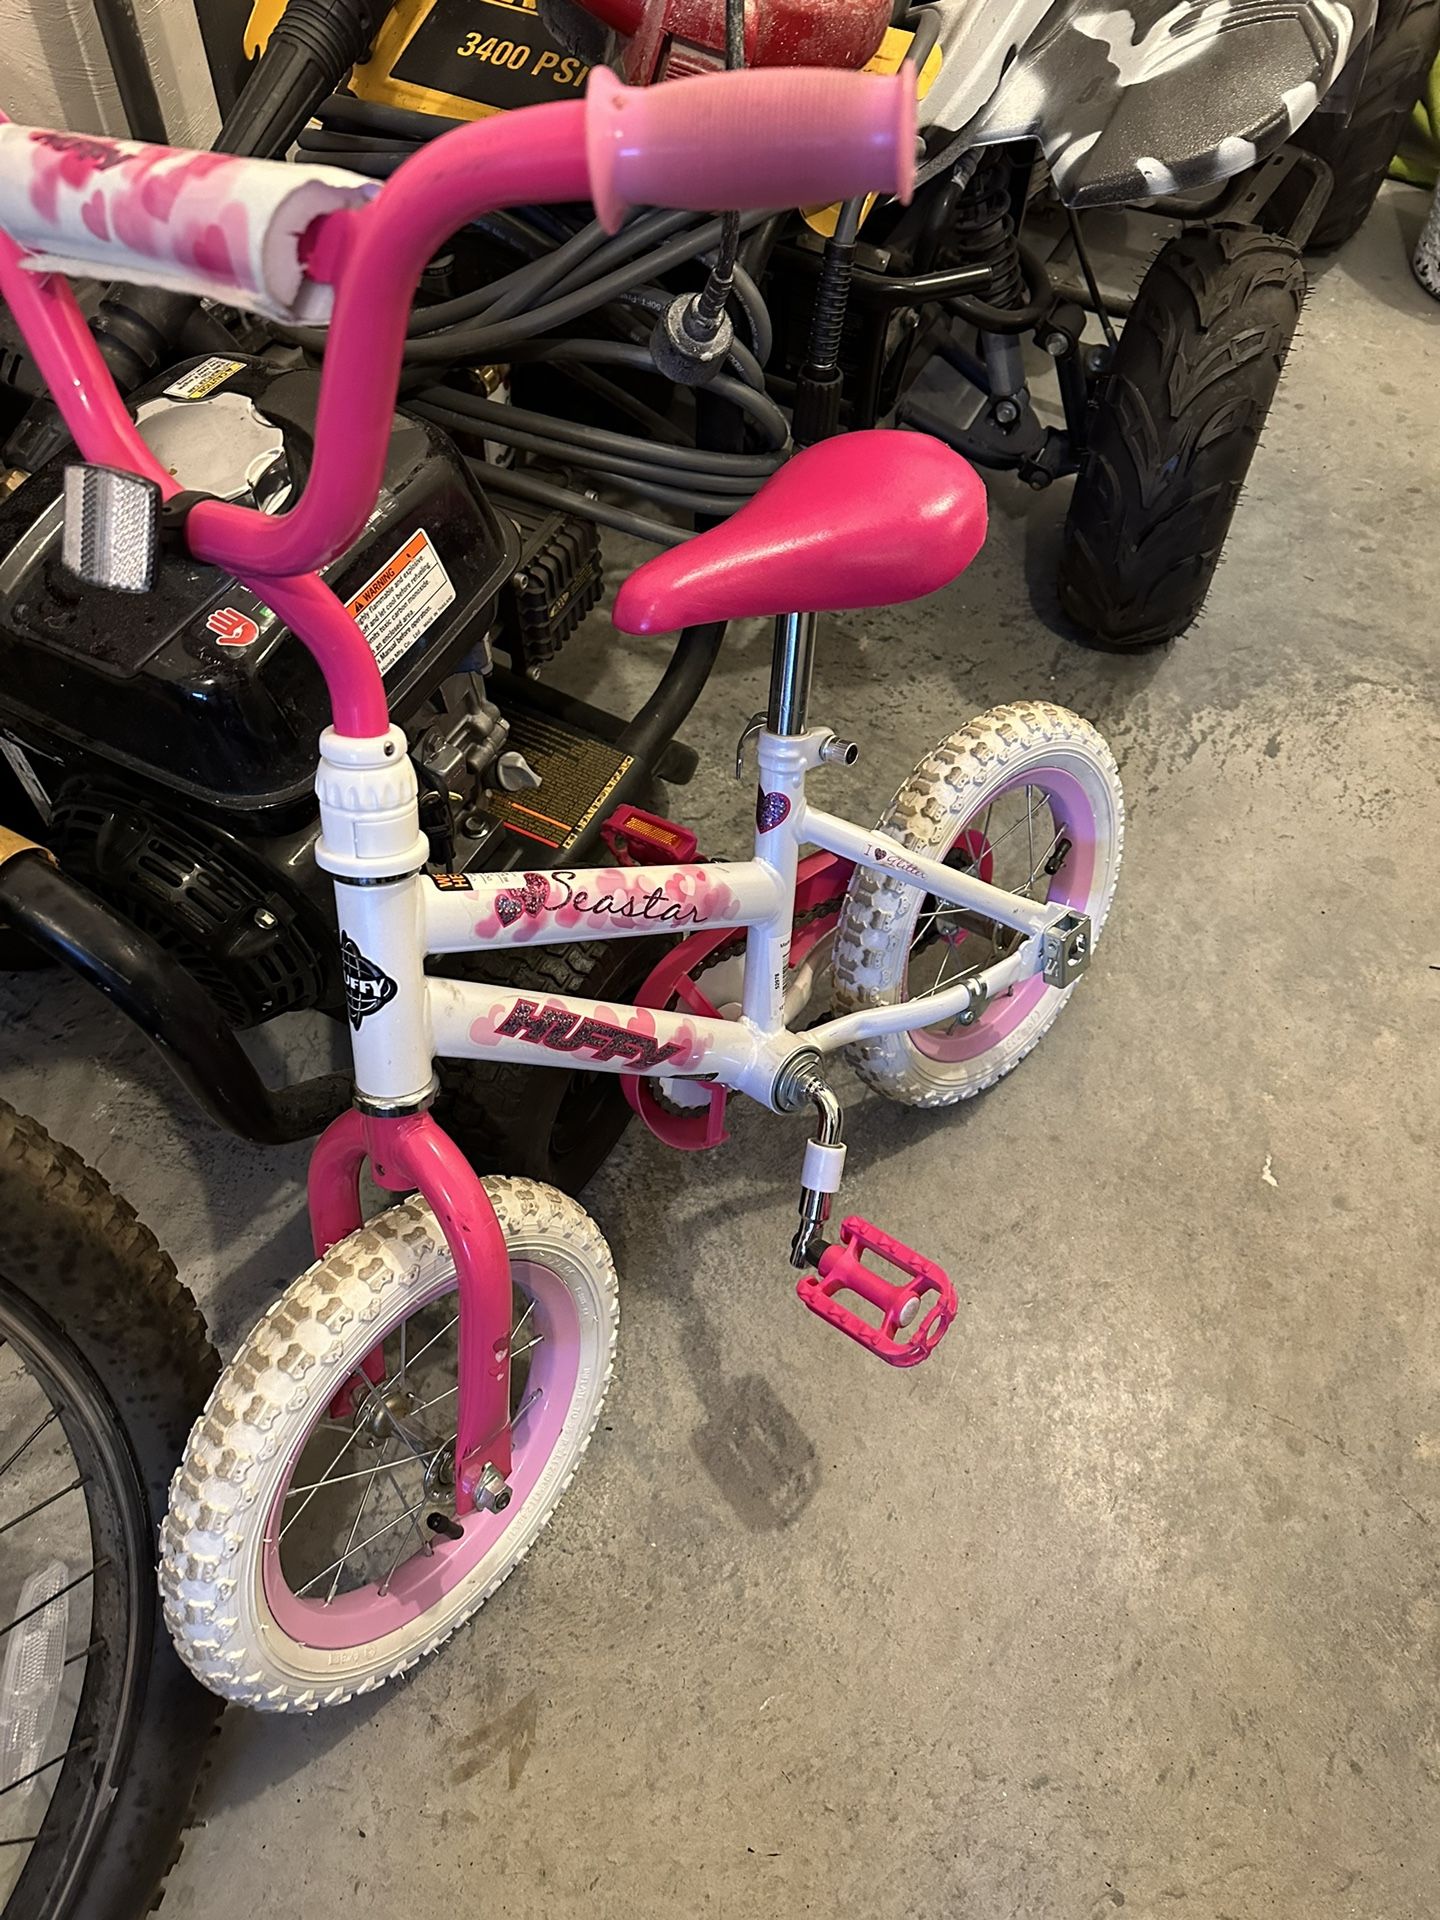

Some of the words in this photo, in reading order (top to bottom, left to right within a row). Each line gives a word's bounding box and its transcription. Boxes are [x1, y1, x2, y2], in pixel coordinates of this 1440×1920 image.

[457, 32, 531, 70] 3400
[531, 51, 590, 87] PSI
[362, 568, 395, 601] WARNING
[368, 586, 394, 613] flammable
[394, 575, 403, 588] and
[370, 614, 379, 627] and
[378, 608, 386, 617] let
[386, 597, 396, 610] cool
[395, 582, 411, 600] before
[379, 619, 392, 633] toxic
[391, 602, 408, 620] carbon
[375, 642, 382, 651] an
[382, 621, 403, 644] enclosed
[379, 640, 397, 660] Manual
[396, 627, 411, 644] before
[543, 871, 708, 923] Seastar
[345, 974, 385, 998] UFFY
[494, 998, 687, 1071] HUFFY
